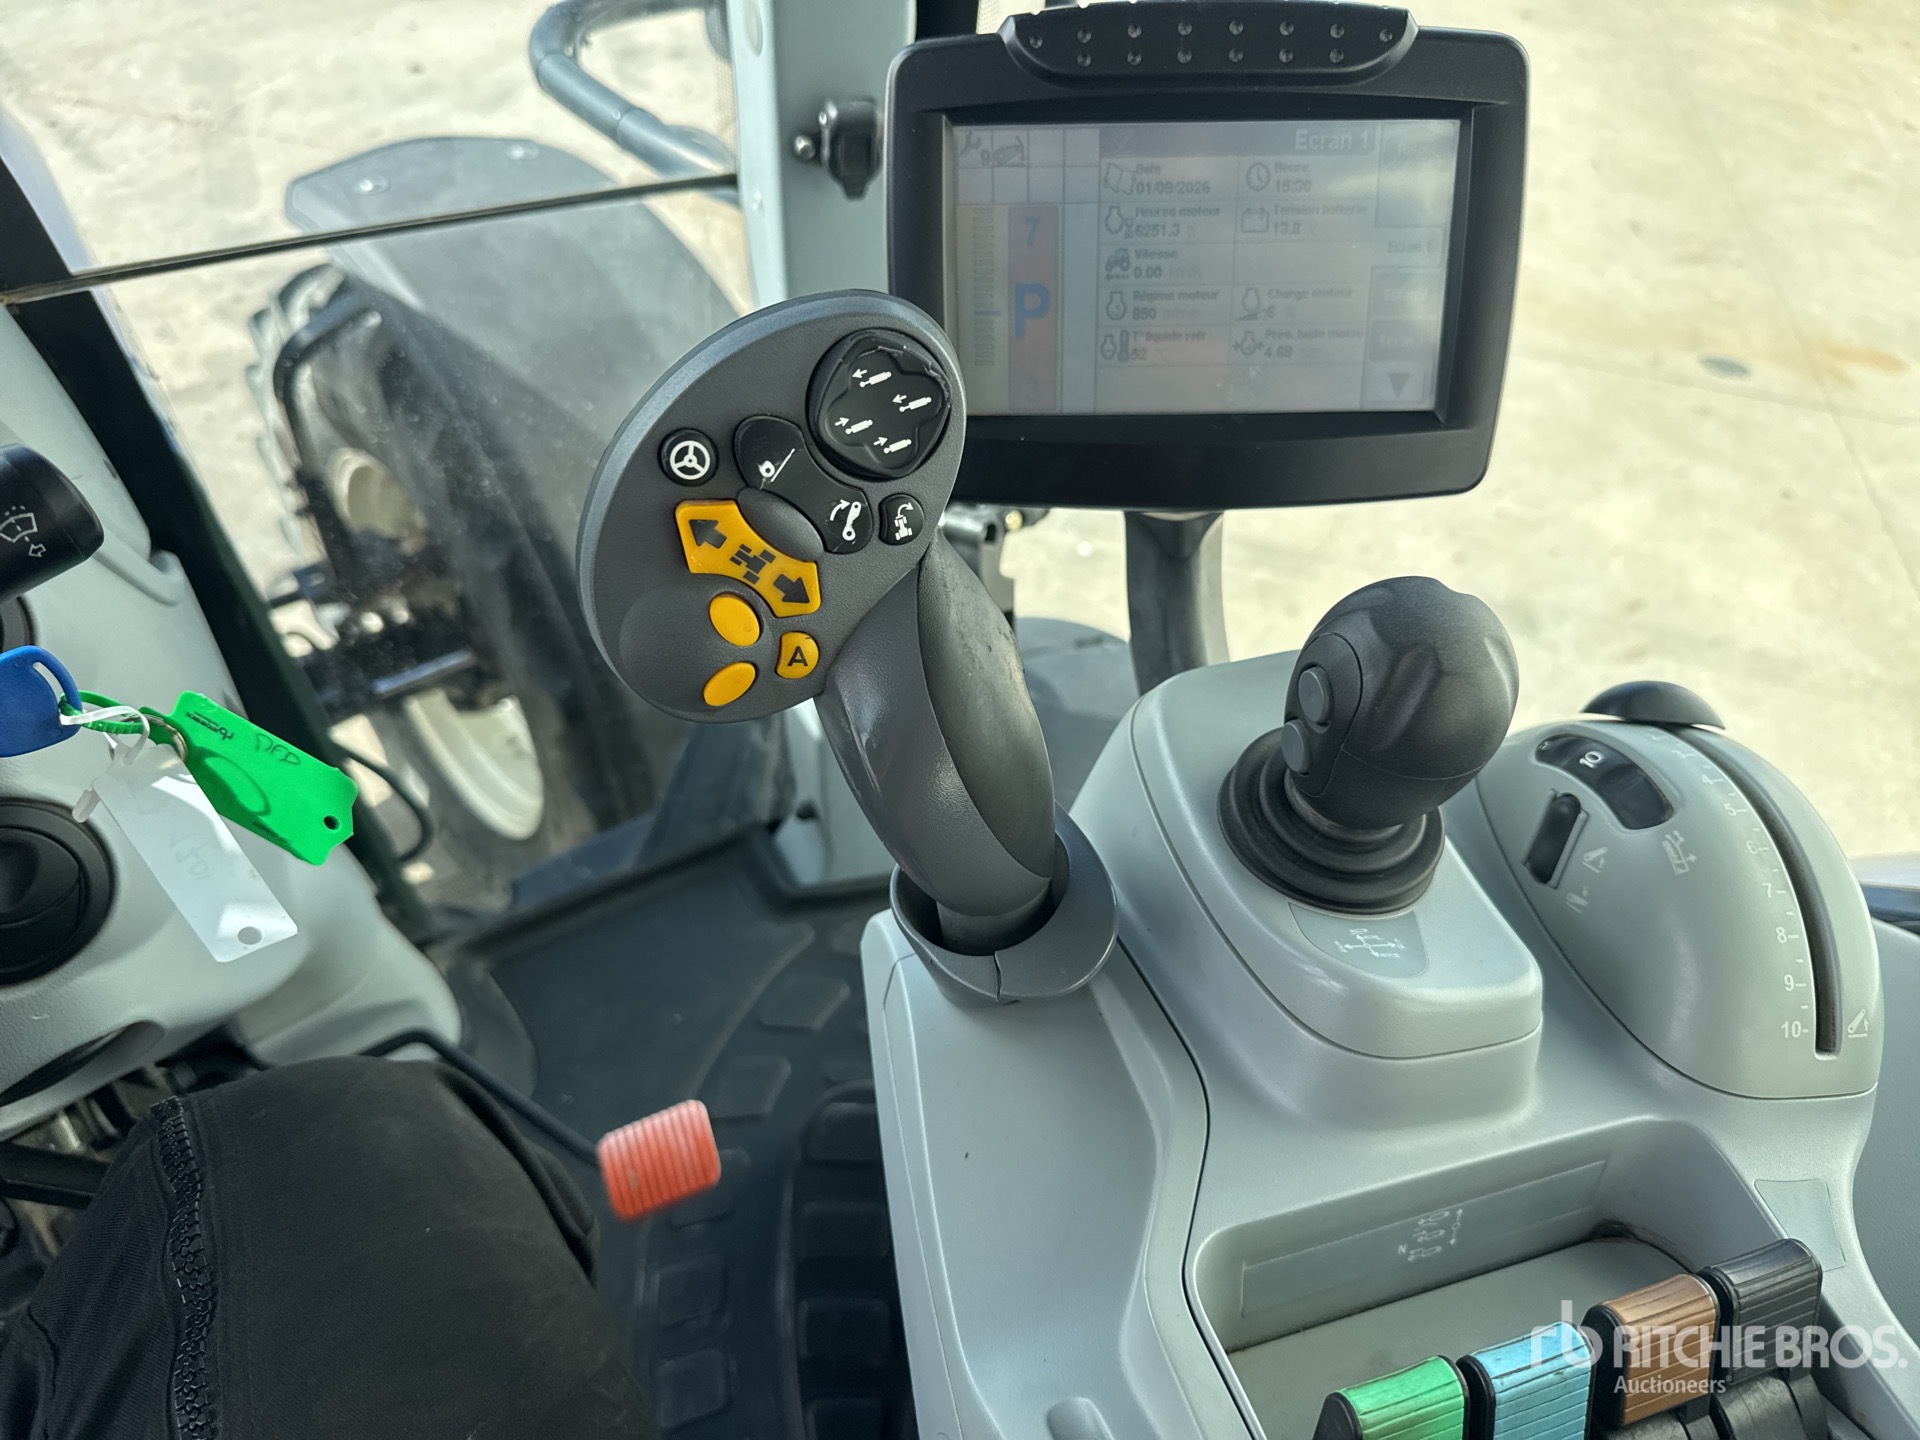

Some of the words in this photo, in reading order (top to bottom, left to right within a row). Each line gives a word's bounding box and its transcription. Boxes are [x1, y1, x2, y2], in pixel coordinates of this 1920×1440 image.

[1295, 129, 1352, 150] Ecran
[1359, 130, 1368, 149] 1
[1025, 216, 1041, 247] 7
[1134, 265, 1162, 279] 0.00
[1015, 283, 1051, 340] P
[787, 646, 809, 667] A
[1579, 751, 1603, 769] 10
[1724, 803, 1737, 816] 5
[1745, 840, 1758, 855] 6
[1762, 882, 1773, 899] 7
[1776, 927, 1787, 943] 8
[1784, 974, 1795, 992] 9
